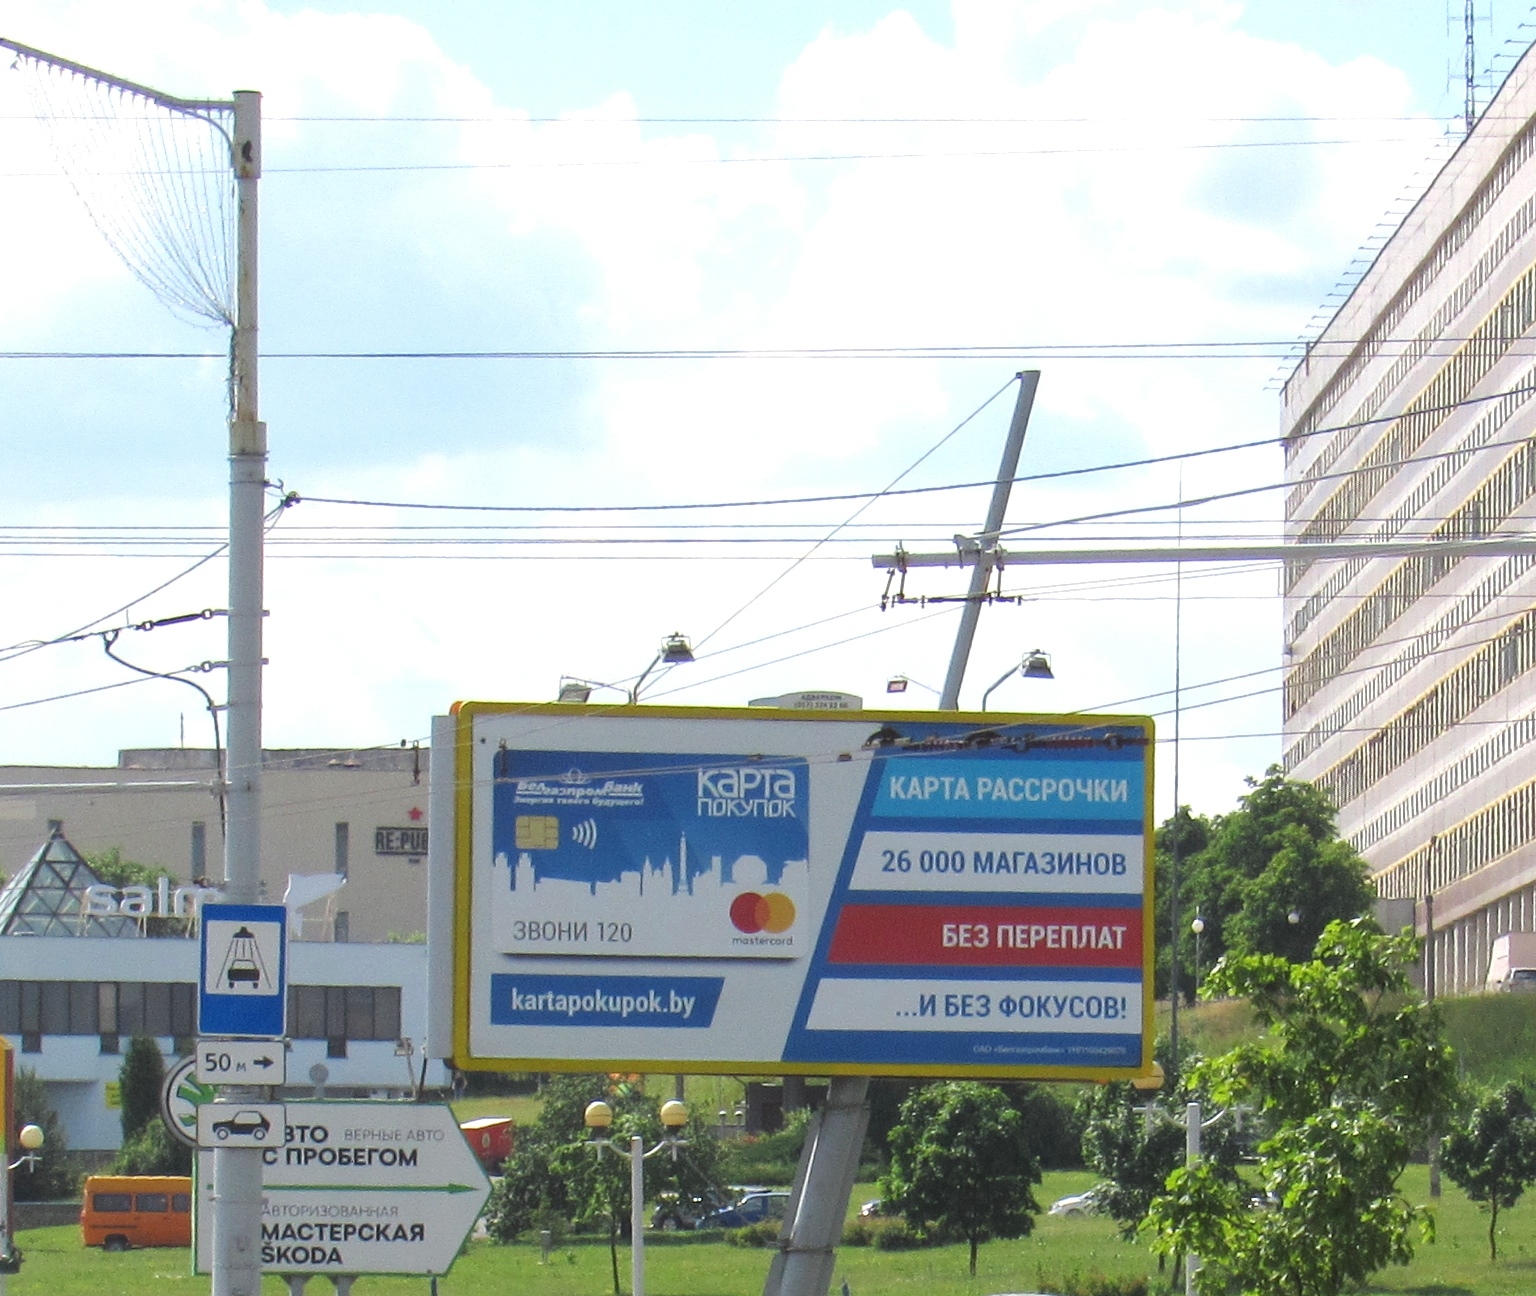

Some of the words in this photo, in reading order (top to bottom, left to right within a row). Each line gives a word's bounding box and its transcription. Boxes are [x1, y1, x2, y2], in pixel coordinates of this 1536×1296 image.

[890, 776, 971, 801] КАРТА
[977, 778, 1128, 802] РАССРОЧКИ
[881, 849, 912, 873] 26
[919, 850, 966, 874] 000
[972, 851, 1127, 876] МАГАЗИНОВ
[513, 921, 588, 942] ЗВОНИ
[597, 921, 633, 943] 120
[941, 923, 990, 948] БЕЗ
[997, 924, 1127, 949] ПЕРЕПЛАТ
[511, 987, 696, 1019] kartapokupok.by
[944, 994, 991, 1017] БЕЗ
[998, 994, 1127, 1019] ФОКУСОВ!
[205, 1052, 232, 1073] 50
[285, 1125, 329, 1143] ВТО
[344, 1128, 402, 1142] ВЕРНЫЕ
[406, 1129, 445, 1142] АВТО
[286, 1147, 418, 1167] ПРОБЕГОМ
[261, 1222, 425, 1242] МАСТЕРСКАЯ
[261, 1241, 343, 1265] ŠKODA
